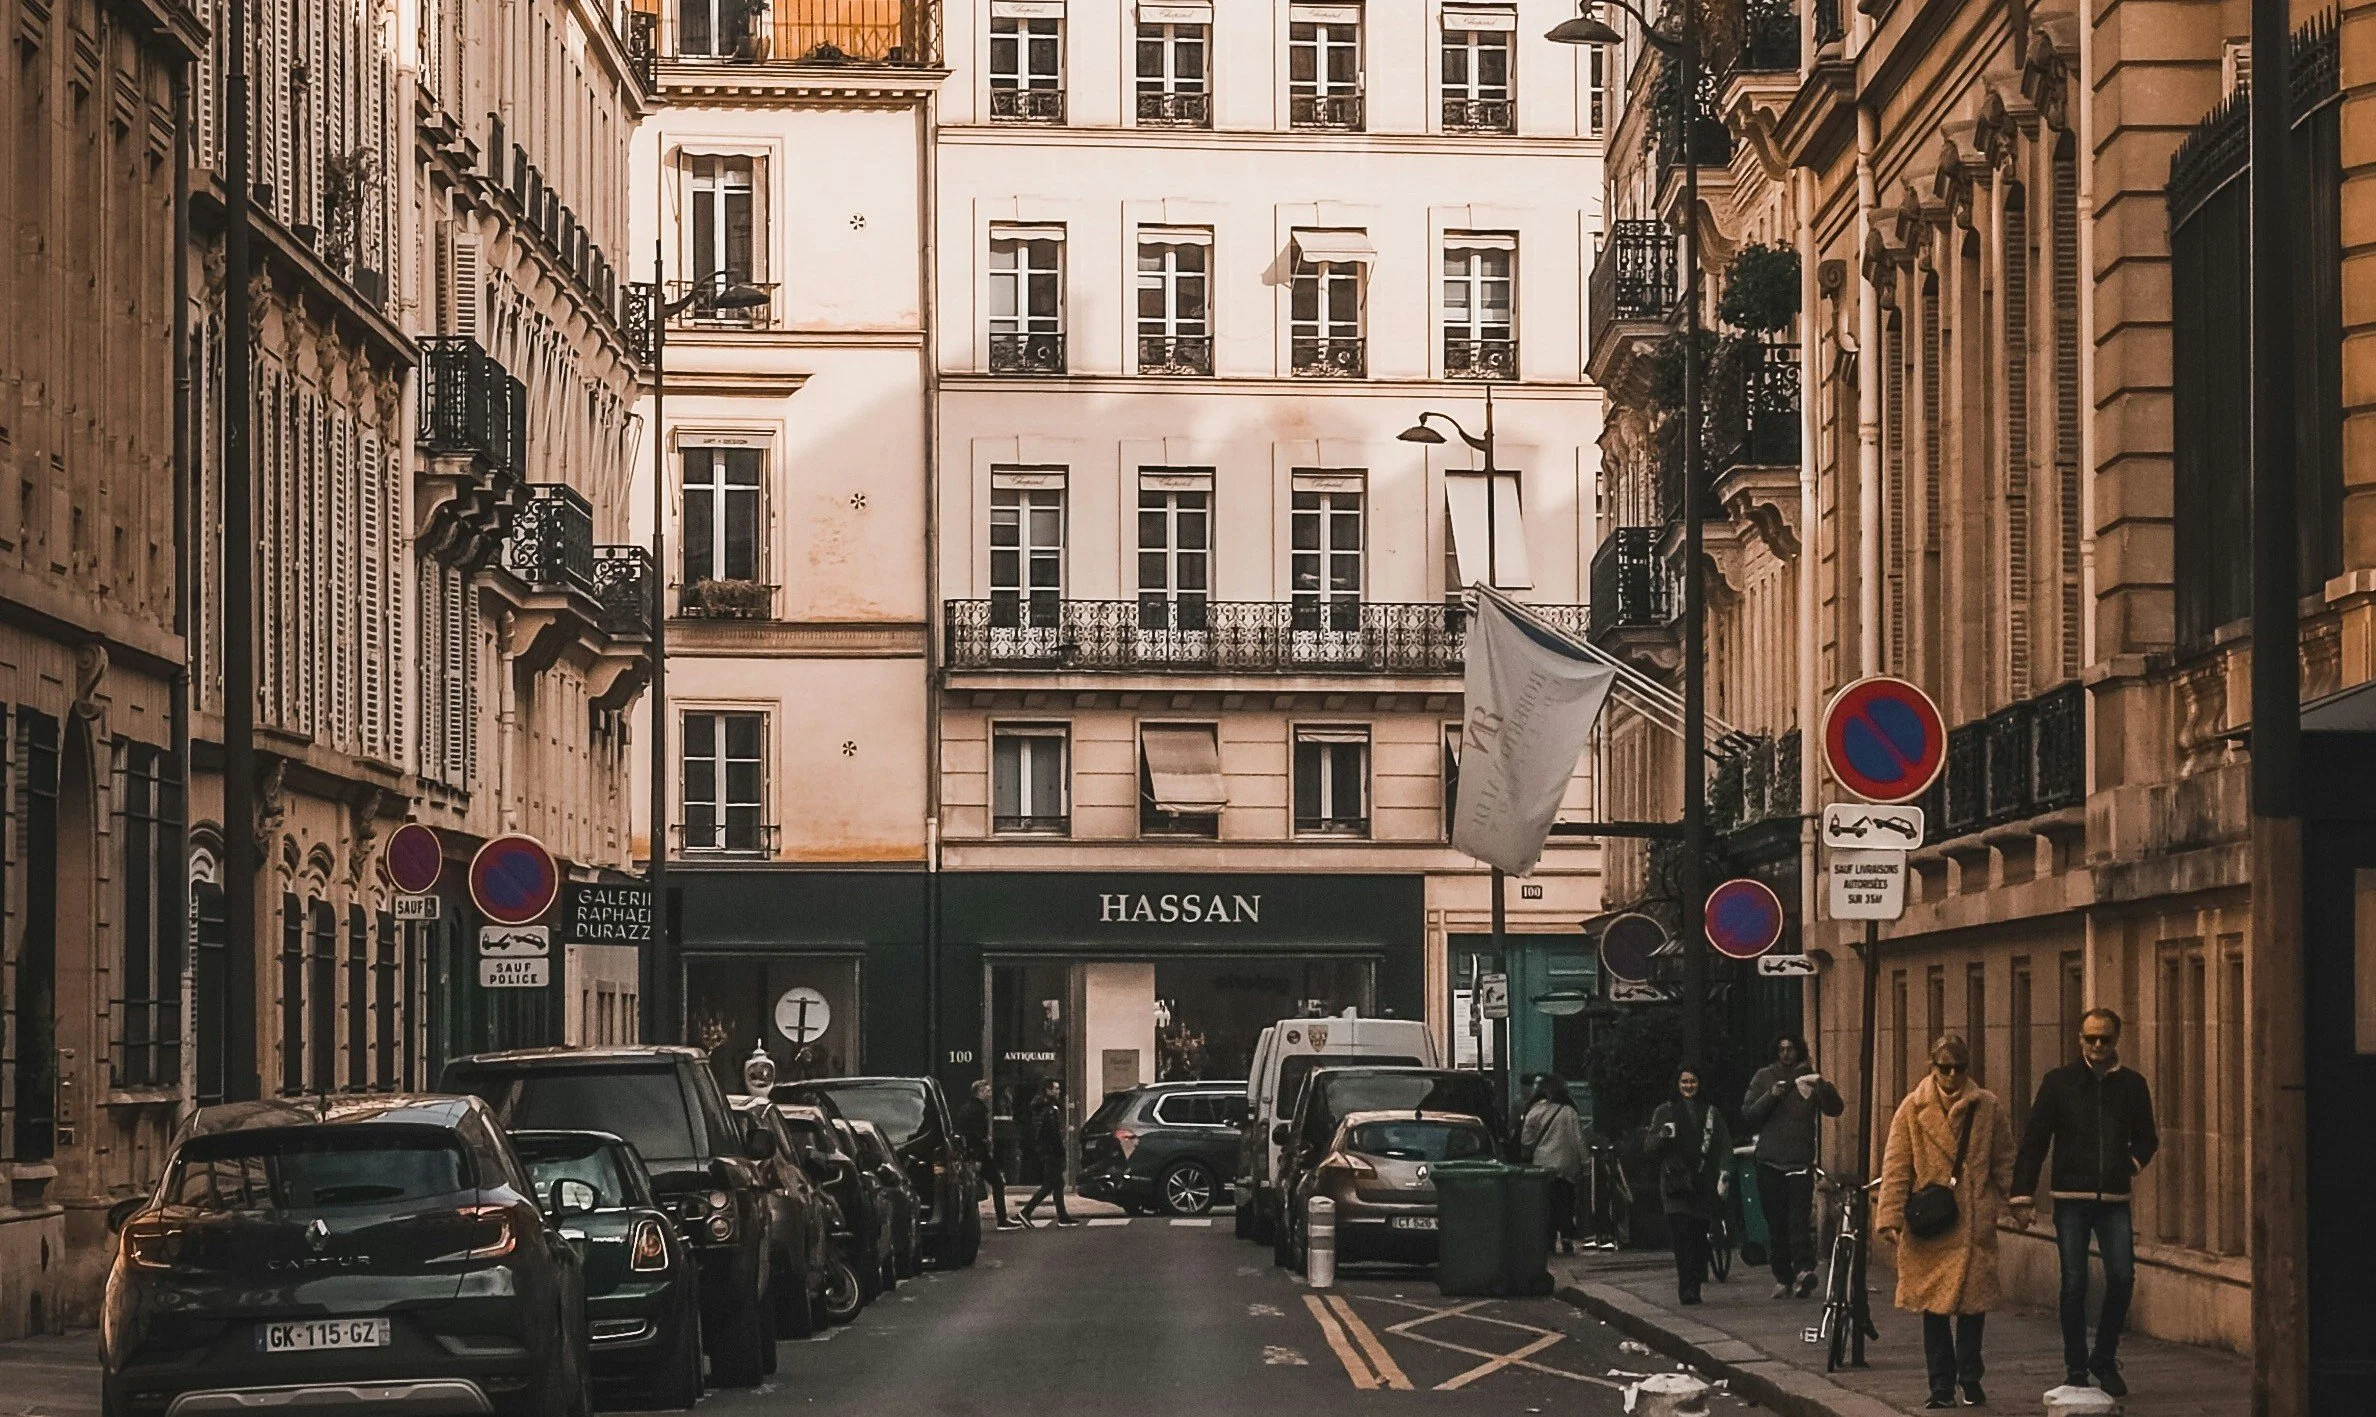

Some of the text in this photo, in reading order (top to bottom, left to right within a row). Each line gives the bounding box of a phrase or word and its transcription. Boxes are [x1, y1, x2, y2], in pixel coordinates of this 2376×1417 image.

[1834, 864, 1853, 874] SAUF
[1523, 886, 1541, 897] 100
[1848, 894, 1863, 904] SUR
[397, 899, 424, 914] SAUF
[1099, 894, 1261, 923] HASSAN
[496, 962, 532, 973] SAUF
[489, 973, 538, 984] POLICE
[949, 1050, 973, 1063] 100
[1004, 1051, 1056, 1062] ANTIQUAIRE
